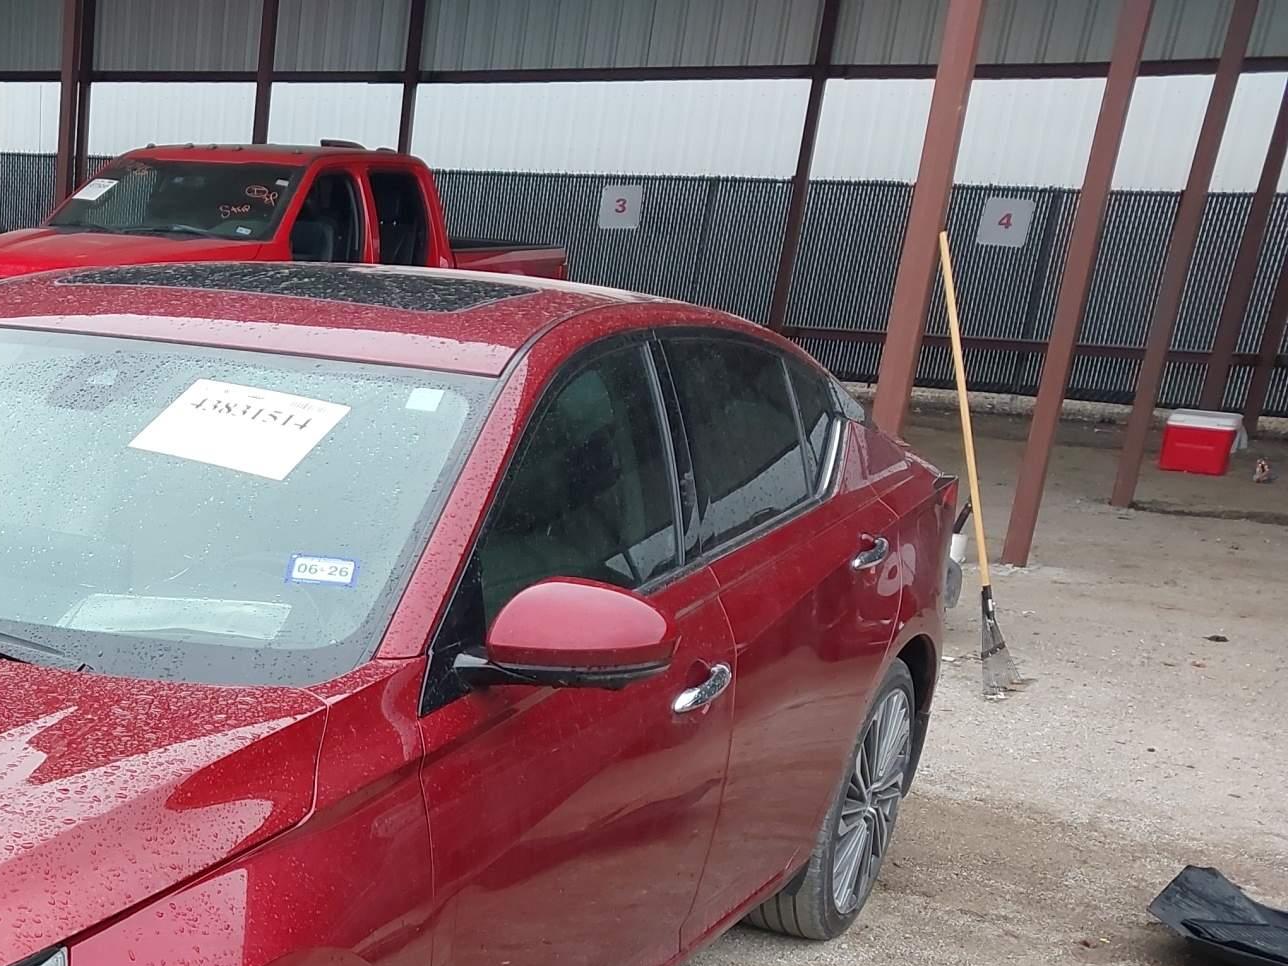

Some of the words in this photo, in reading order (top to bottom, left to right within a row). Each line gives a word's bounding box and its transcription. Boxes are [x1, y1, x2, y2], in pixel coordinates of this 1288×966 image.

[615, 198, 627, 213] 3
[998, 213, 1012, 229] 4
[190, 398, 312, 430] 43831514
